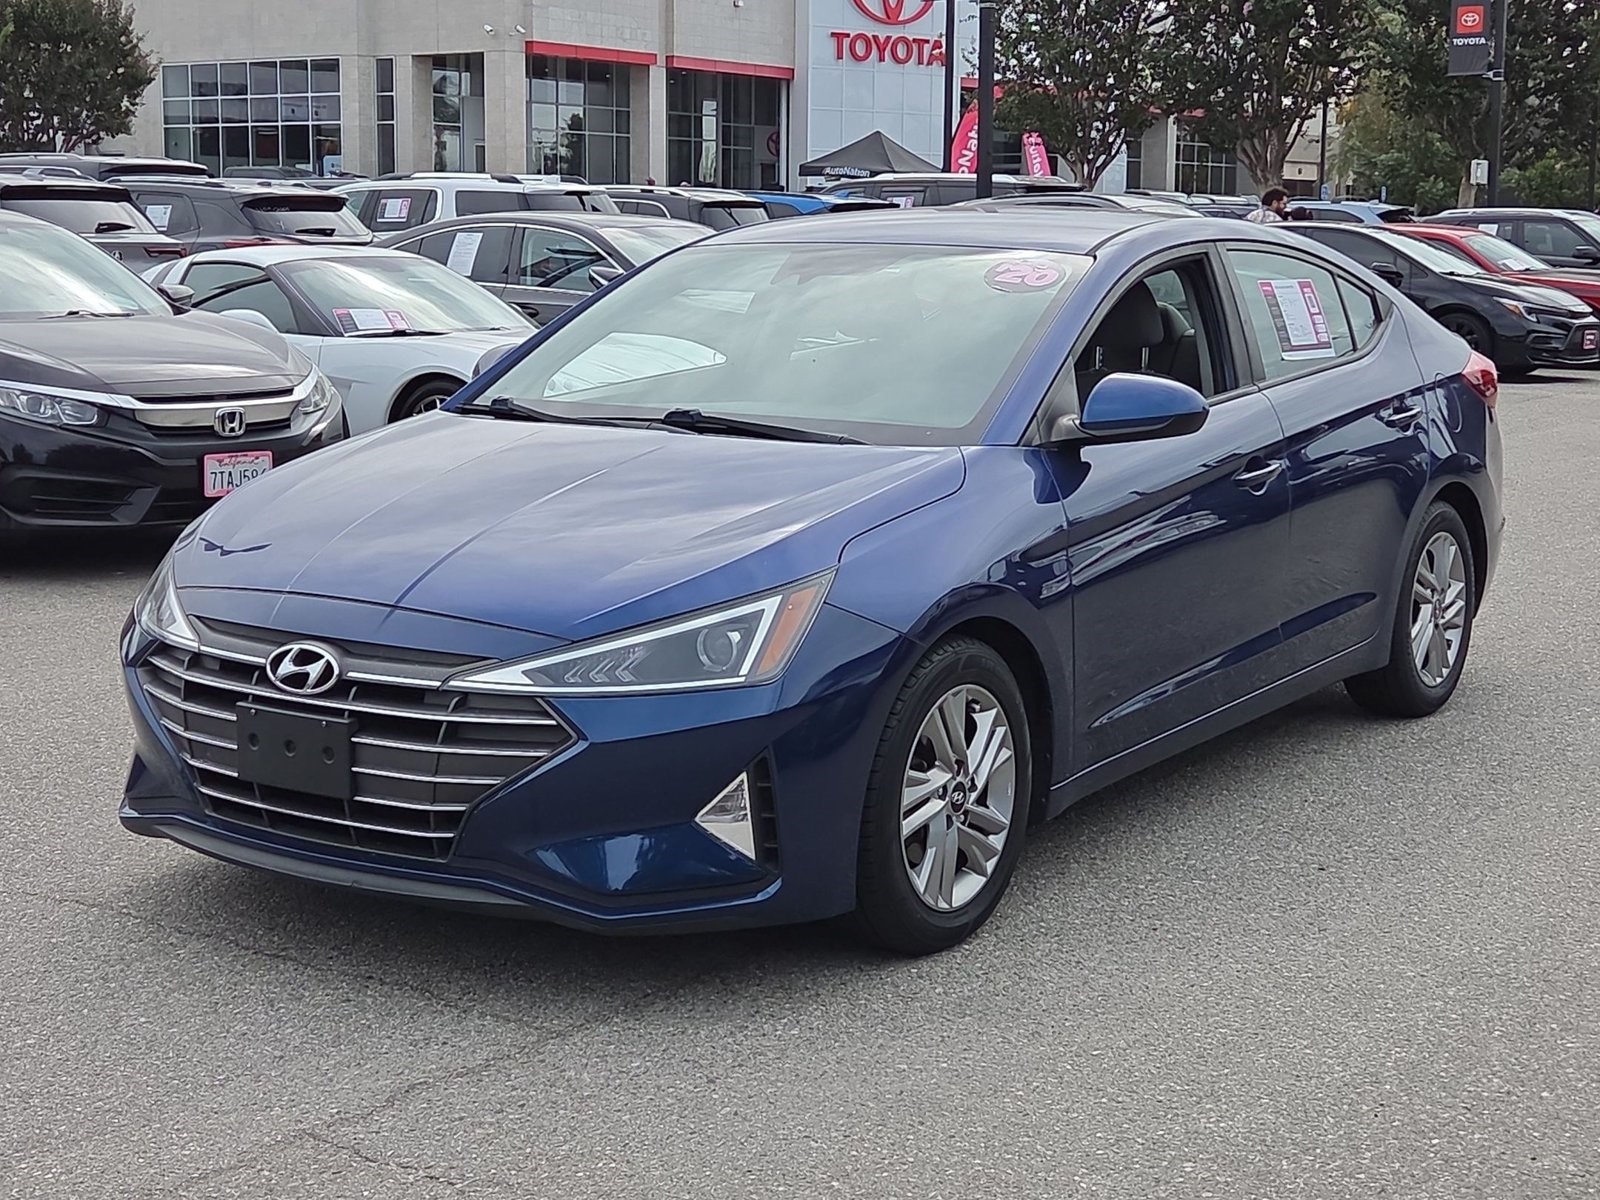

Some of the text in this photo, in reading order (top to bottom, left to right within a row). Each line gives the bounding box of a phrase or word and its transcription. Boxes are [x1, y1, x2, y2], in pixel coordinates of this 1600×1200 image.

[1452, 37, 1487, 46] TOYOTA
[830, 31, 946, 66] TOYOTA
[823, 166, 871, 177] AutoNation
